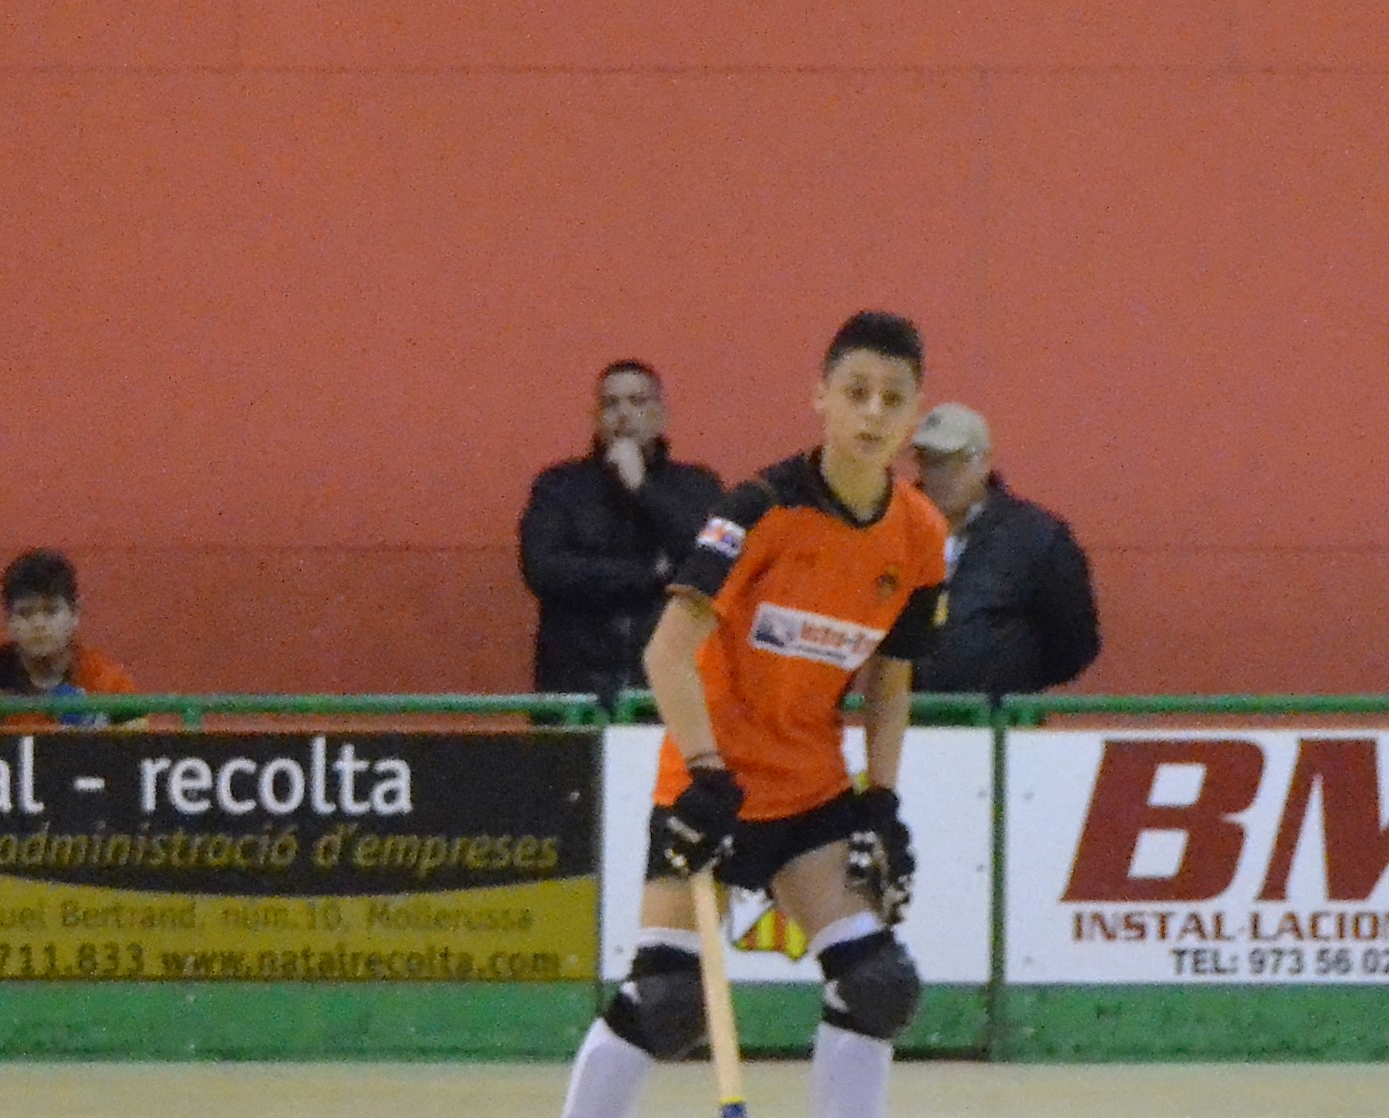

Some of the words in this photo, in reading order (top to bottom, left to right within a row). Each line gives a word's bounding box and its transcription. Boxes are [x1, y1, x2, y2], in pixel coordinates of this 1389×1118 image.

[140, 735, 414, 816] recolta
[1248, 948, 1304, 976] 973
[1314, 948, 1352, 976] 56
